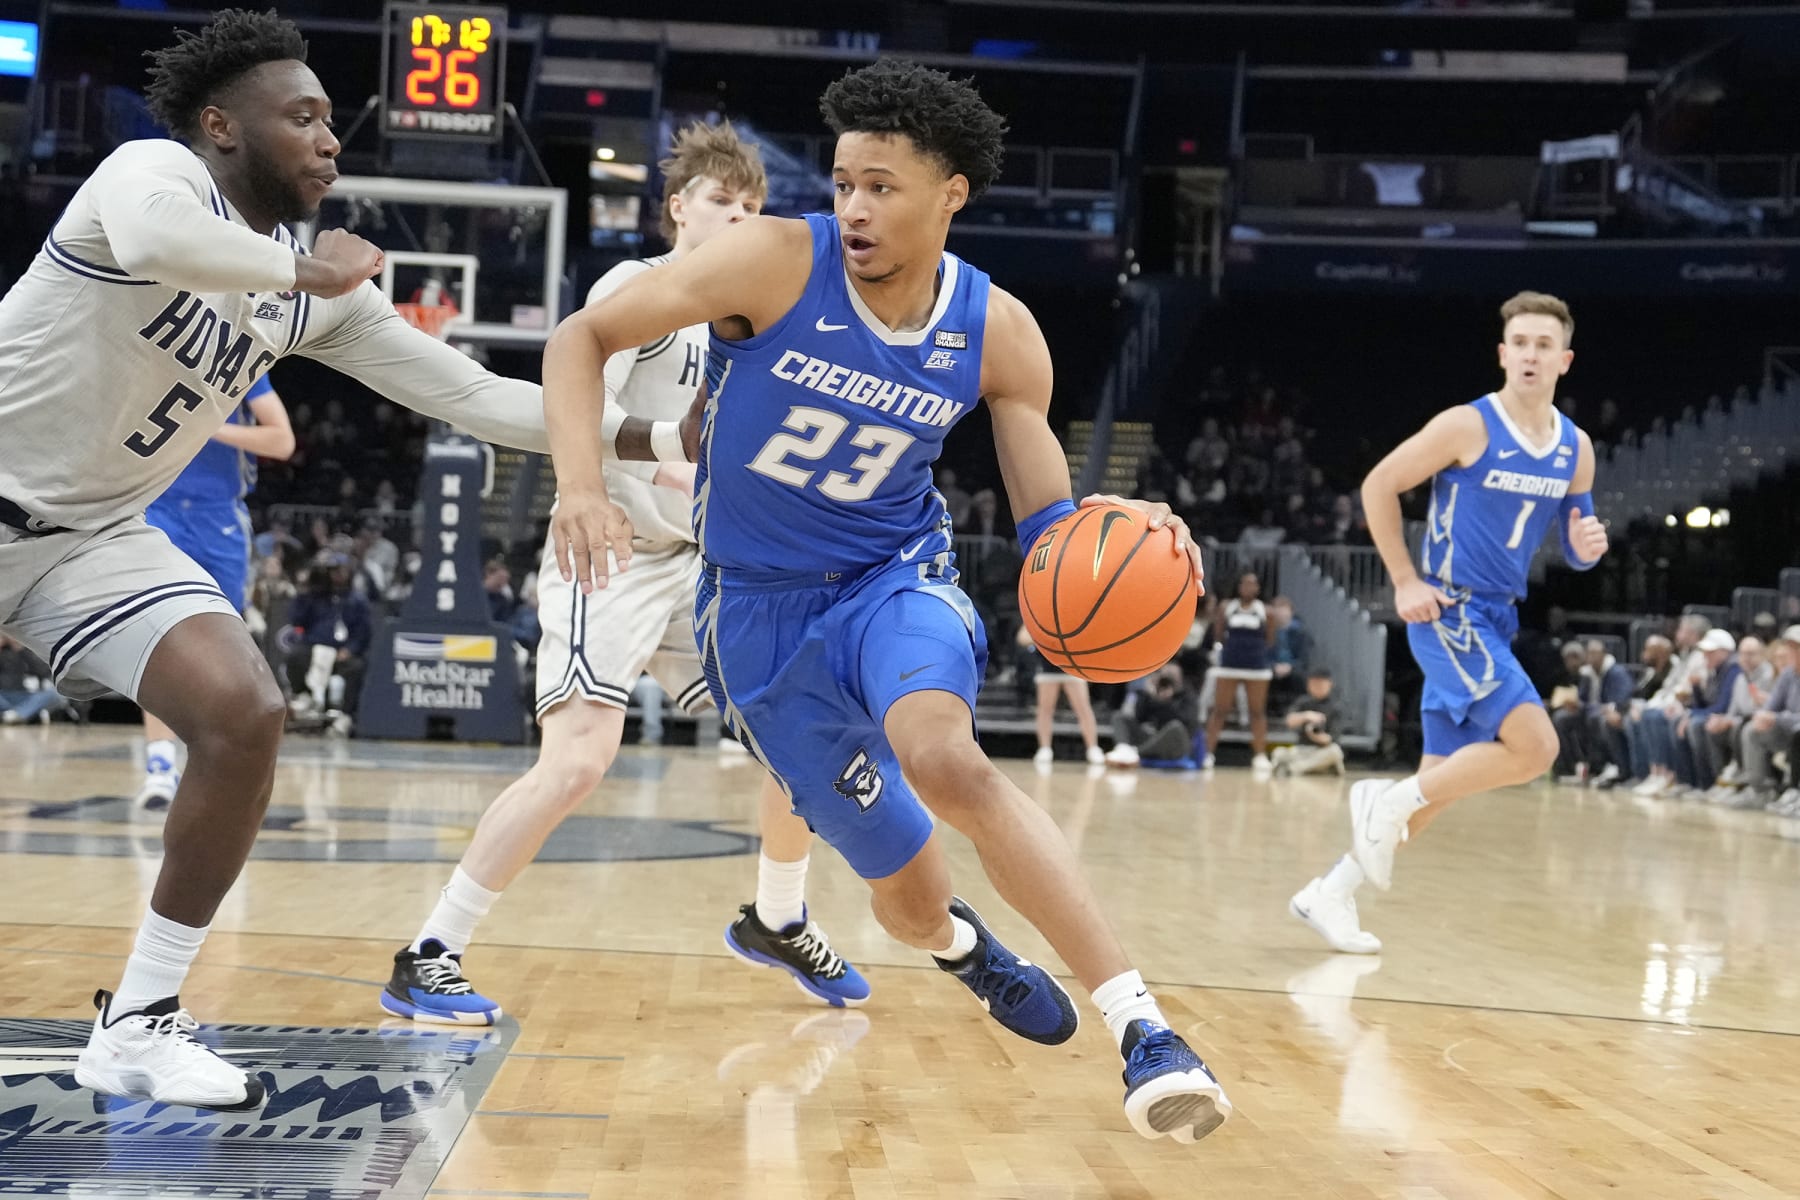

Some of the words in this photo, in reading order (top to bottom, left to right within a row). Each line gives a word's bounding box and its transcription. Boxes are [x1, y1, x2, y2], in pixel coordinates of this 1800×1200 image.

[411, 15, 491, 53] 17:12
[406, 47, 479, 107] 26
[255, 308, 285, 319] EAST
[260, 301, 280, 311] BIG
[930, 350, 952, 359] BIG
[935, 340, 966, 348] CHANGE
[926, 357, 957, 367] EAST
[770, 350, 964, 427] CREIGHTON
[121, 380, 204, 459] 5
[744, 405, 917, 502] 23
[1505, 500, 1537, 549] 1
[436, 473, 462, 612] HOYAS
[394, 660, 495, 688] MedStar
[401, 682, 483, 709] Health
